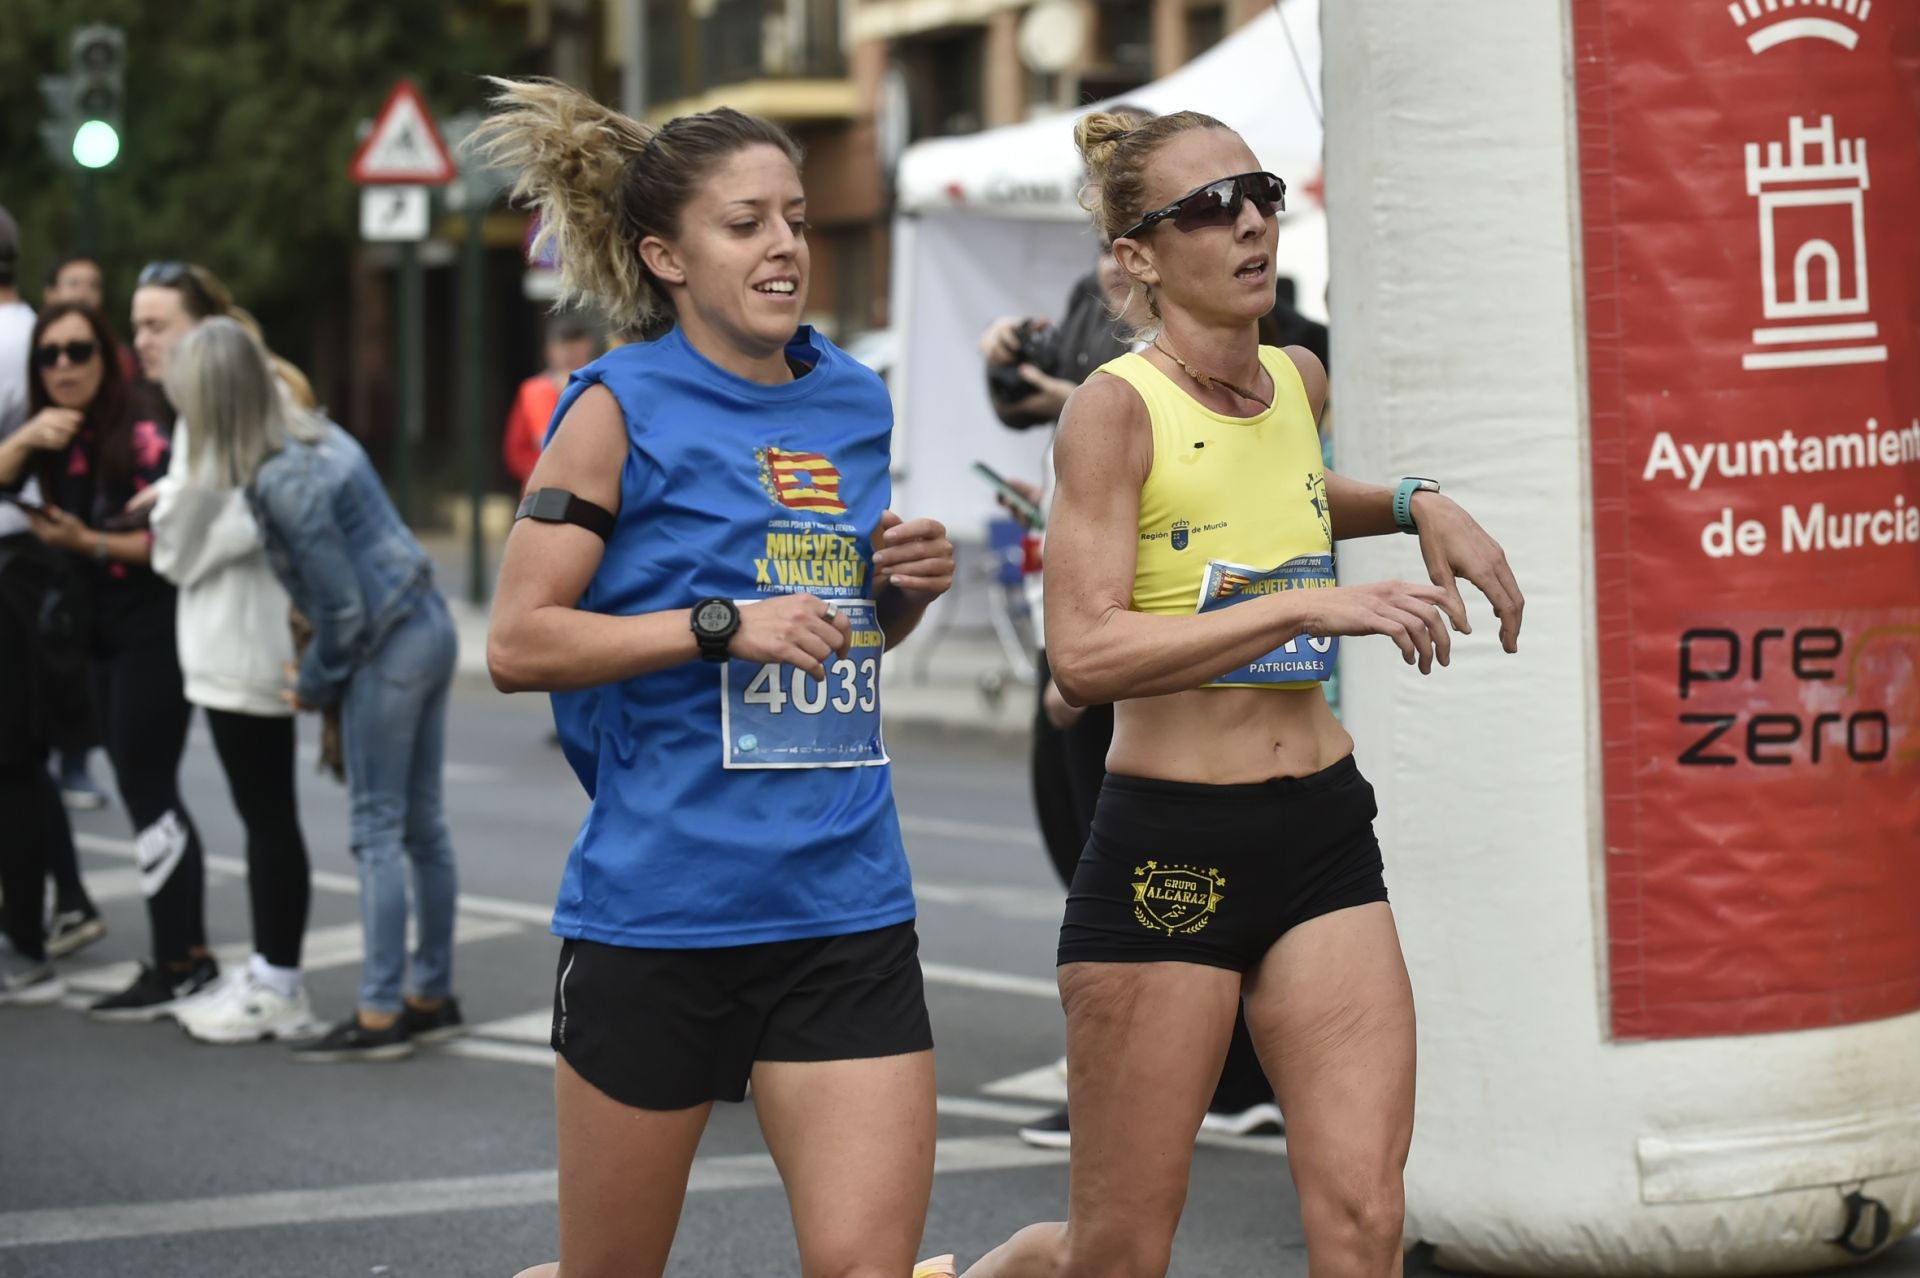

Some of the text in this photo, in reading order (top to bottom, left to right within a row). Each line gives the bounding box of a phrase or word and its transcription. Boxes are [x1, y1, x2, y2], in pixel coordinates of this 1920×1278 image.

[1141, 521, 1228, 542] Región de Murcia
[1701, 494, 1919, 557] de Murcia
[766, 529, 859, 560] MUÉVETE
[754, 559, 771, 584] X
[1249, 660, 1325, 674] PATRICIA&ES
[1679, 628, 1843, 699] pre
[743, 657, 877, 715] 4033
[1677, 710, 1889, 766] zero
[1146, 886, 1208, 905] ALCARAZ
[1164, 878, 1197, 891] GRUPO
